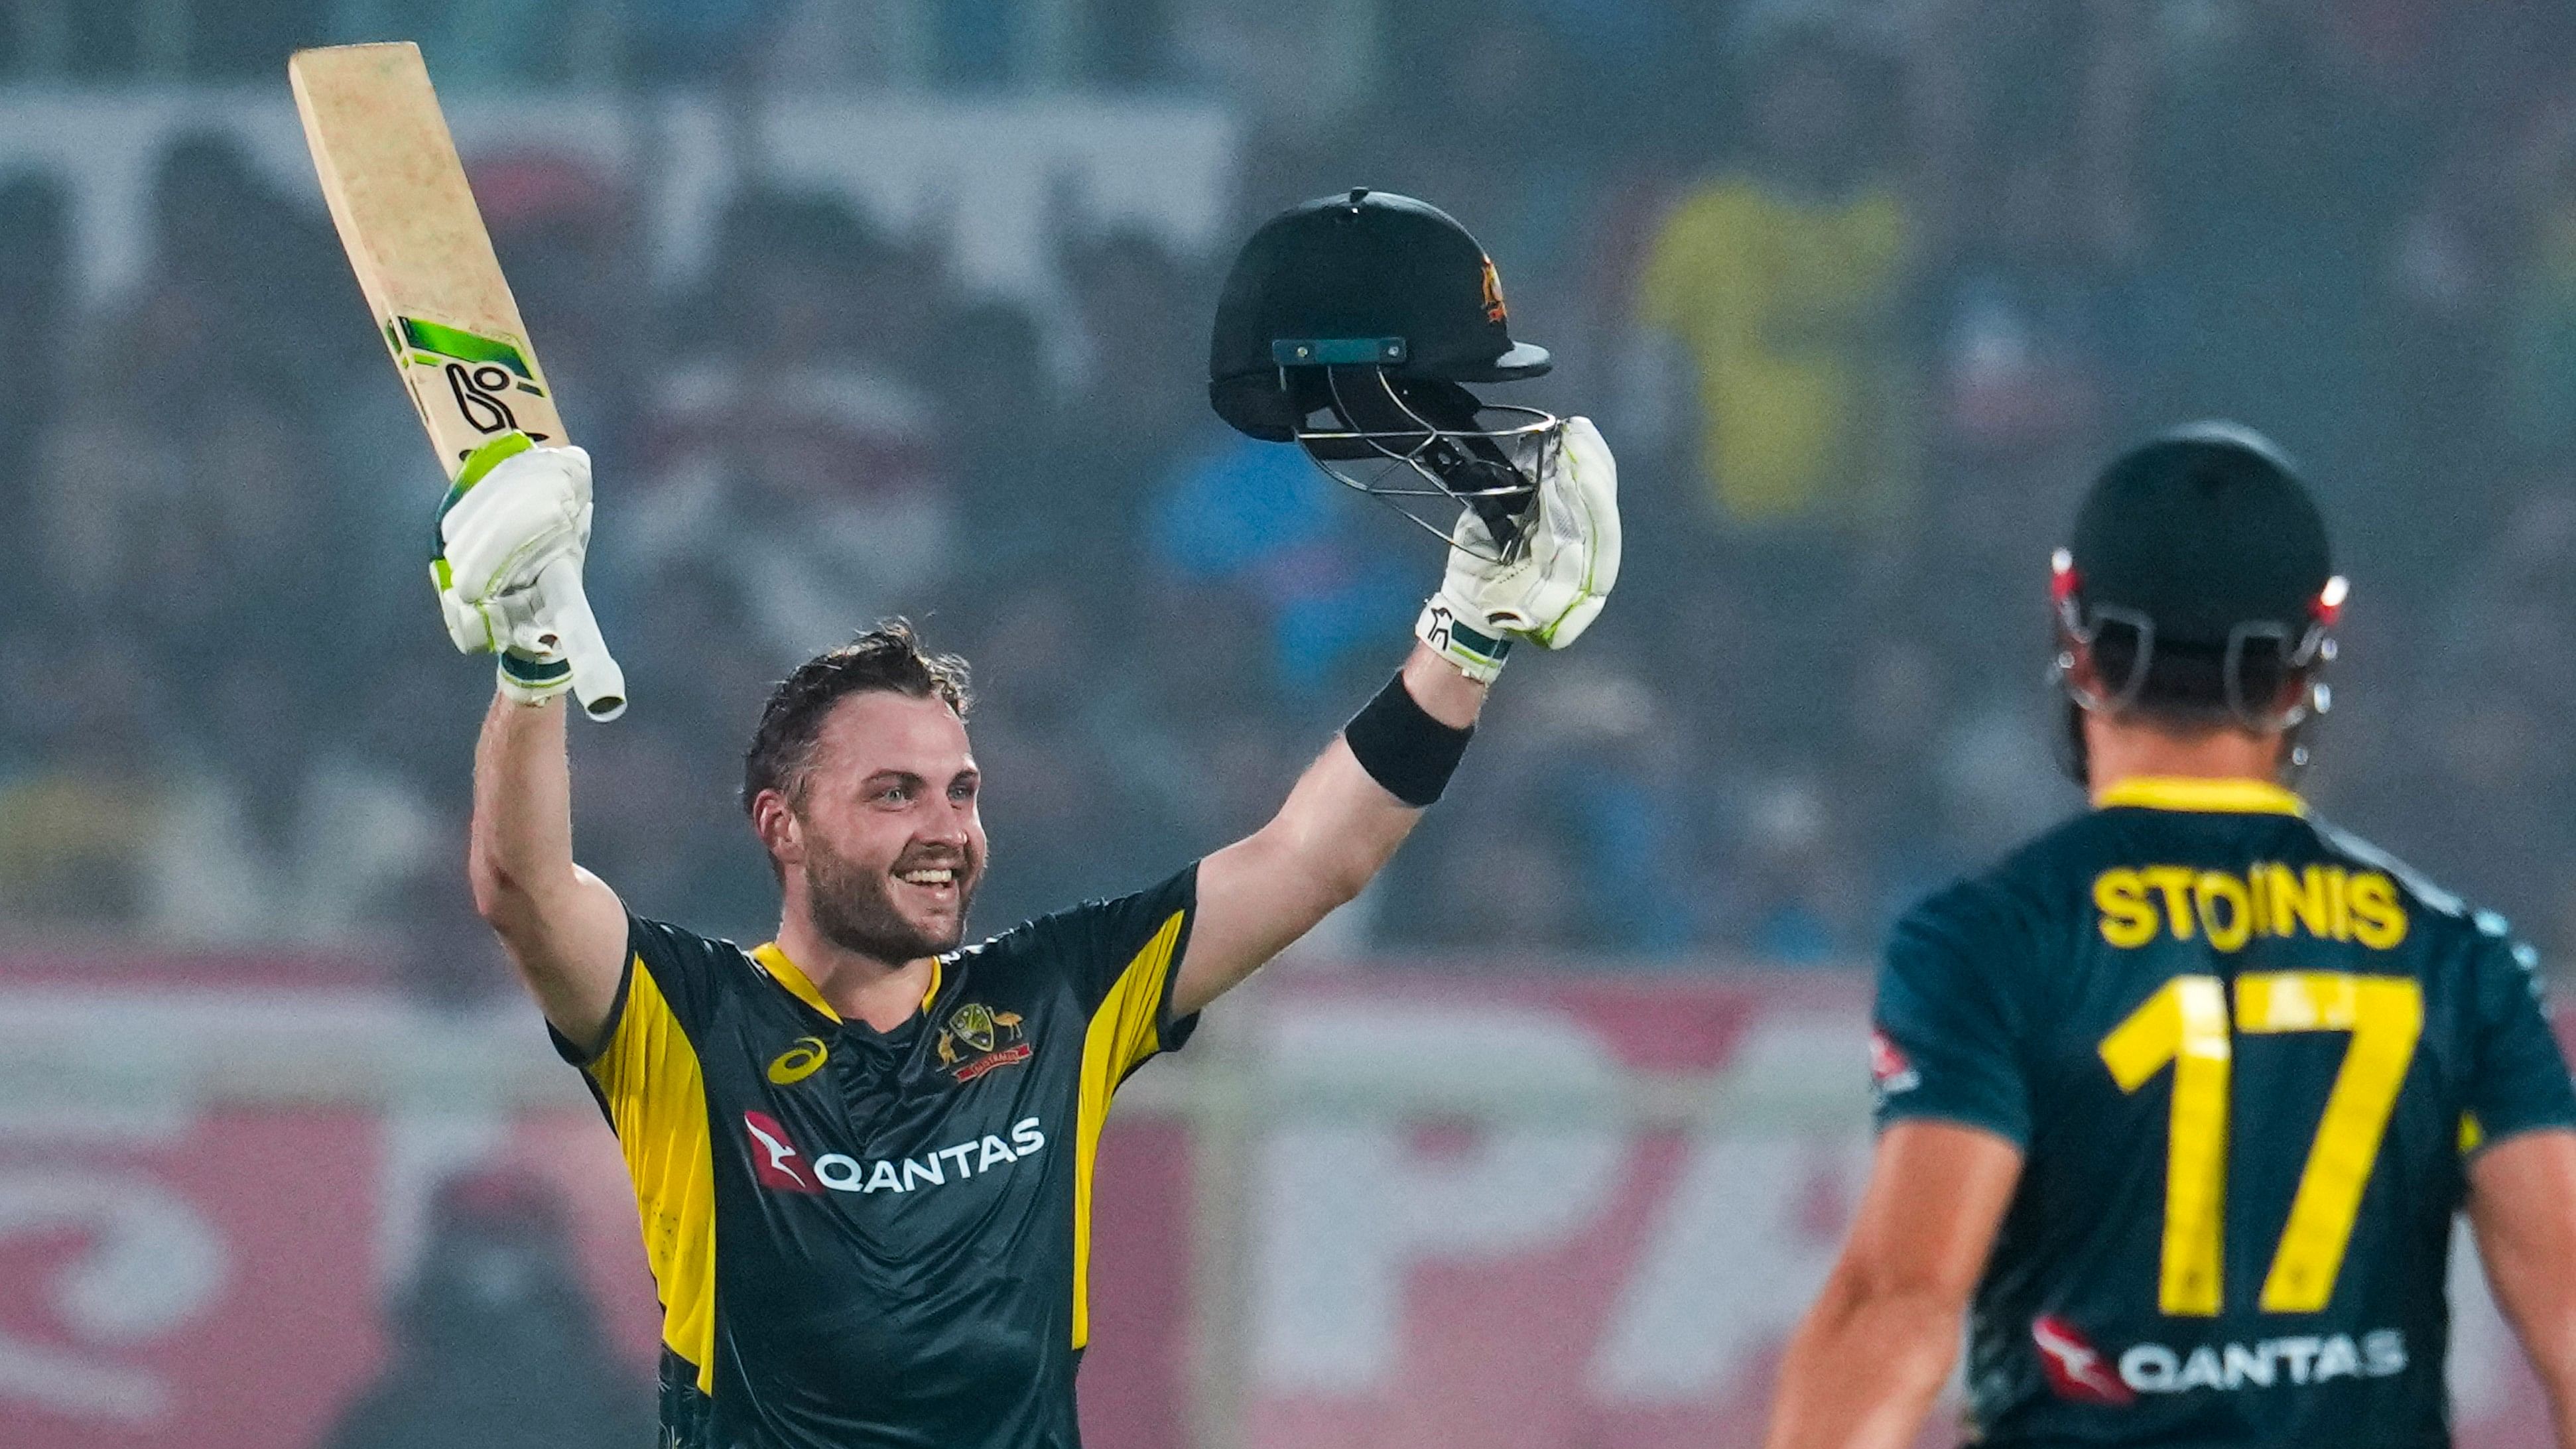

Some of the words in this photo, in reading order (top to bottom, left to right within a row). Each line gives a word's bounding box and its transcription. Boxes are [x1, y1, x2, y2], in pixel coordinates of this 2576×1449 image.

[2094, 862, 2408, 952] STOINIS
[814, 1117, 1045, 1193] QANTAS
[2098, 973, 2423, 1316] 17
[2120, 1330, 2408, 1393] QANTAS
